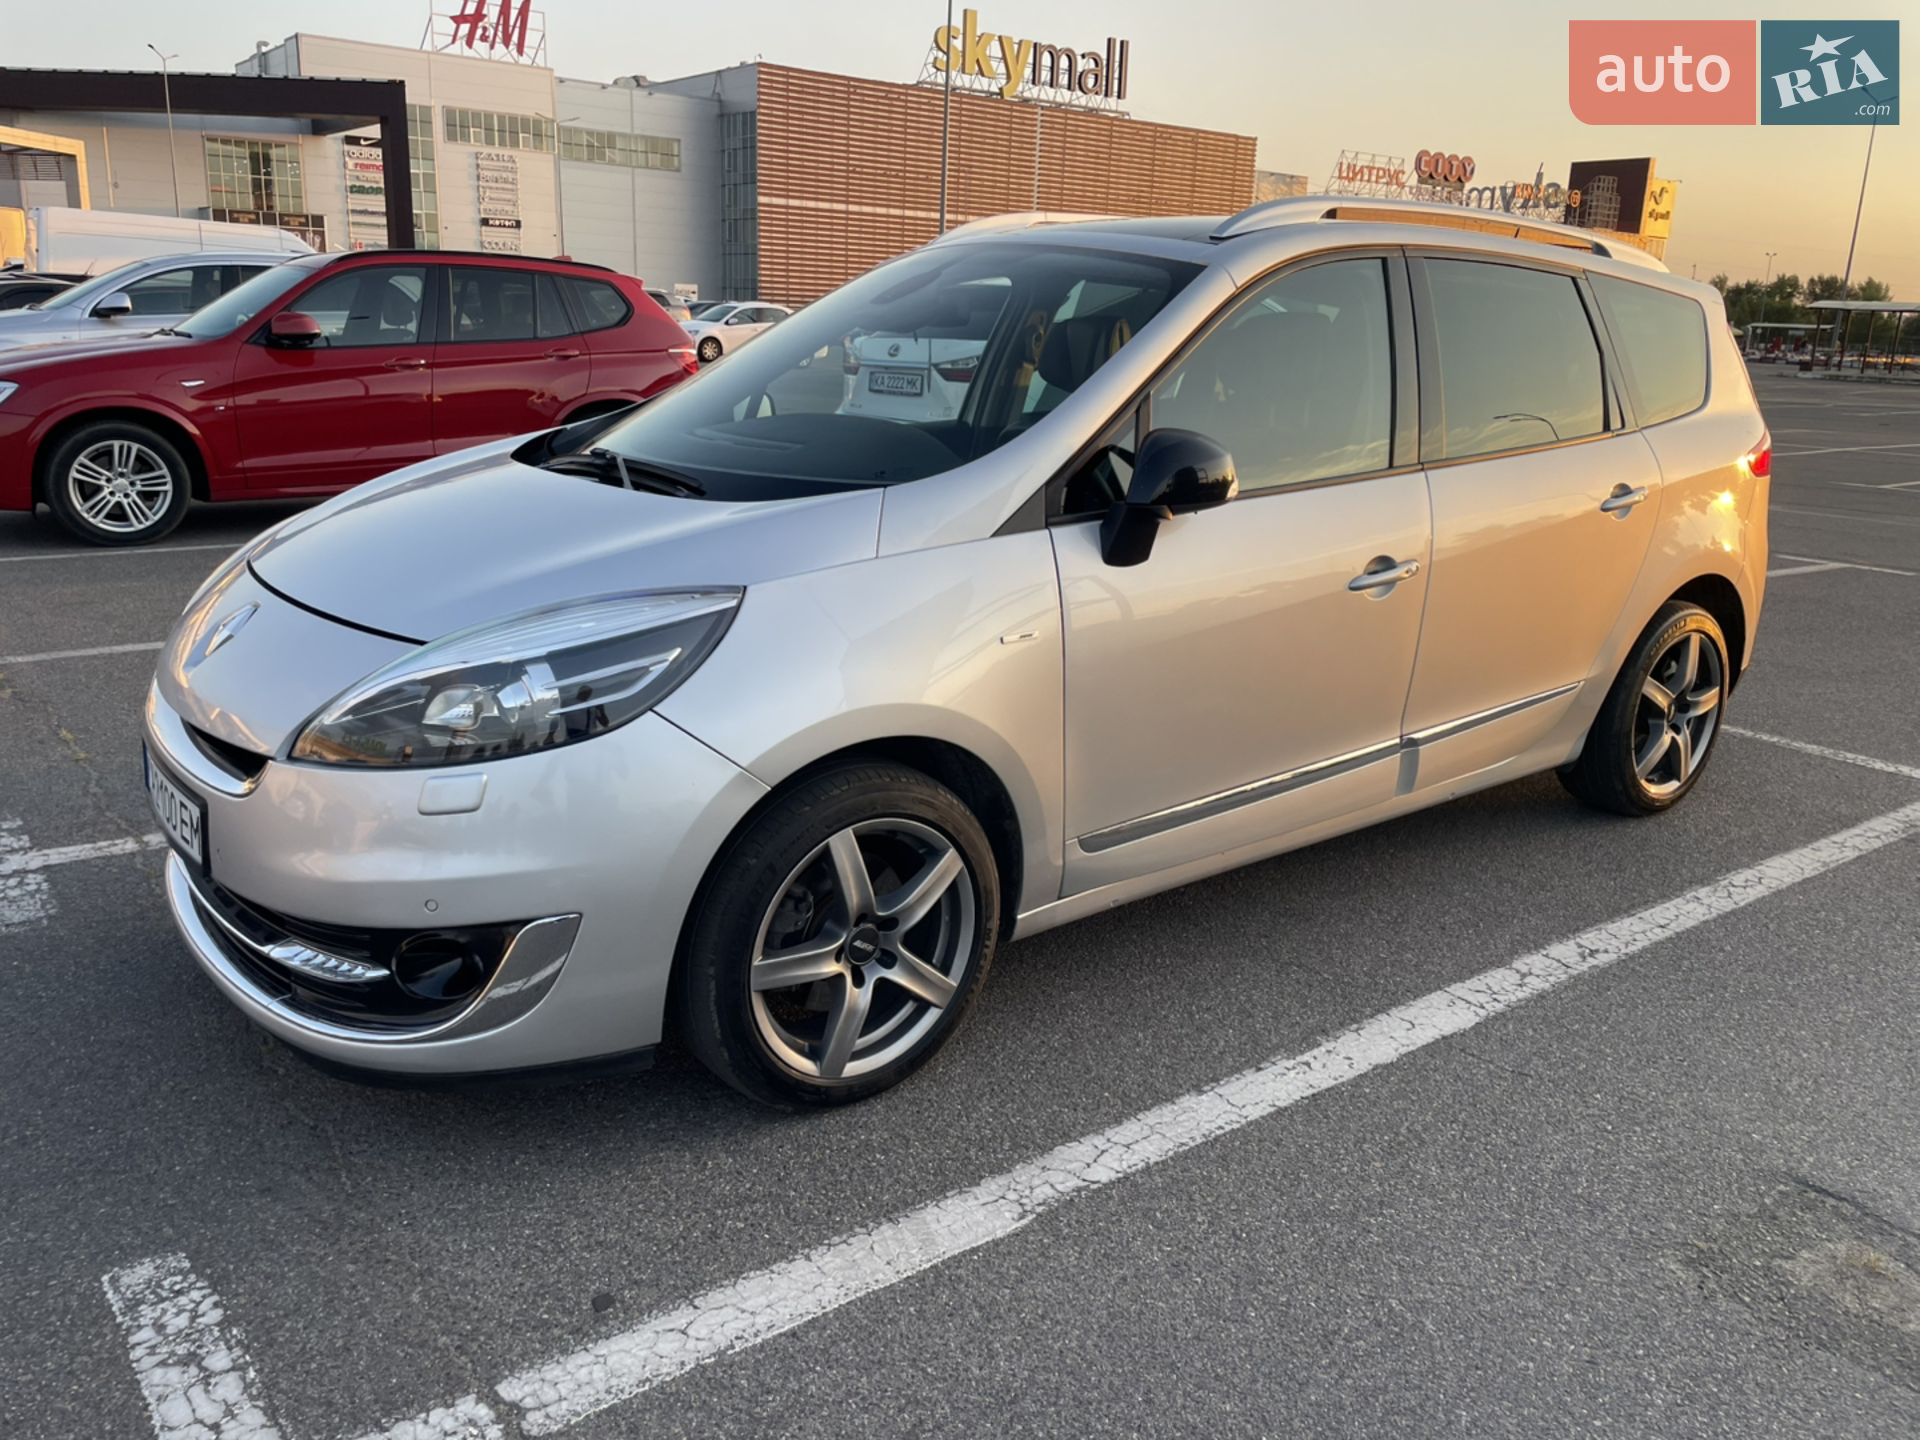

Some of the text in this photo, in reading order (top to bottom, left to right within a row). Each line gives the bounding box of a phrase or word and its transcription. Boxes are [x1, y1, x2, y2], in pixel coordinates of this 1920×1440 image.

[449, 0, 531, 57] H&M
[932, 8, 1129, 100] skymall
[1338, 161, 1406, 188] ЦИТРУС
[1418, 153, 1475, 177] CITY
